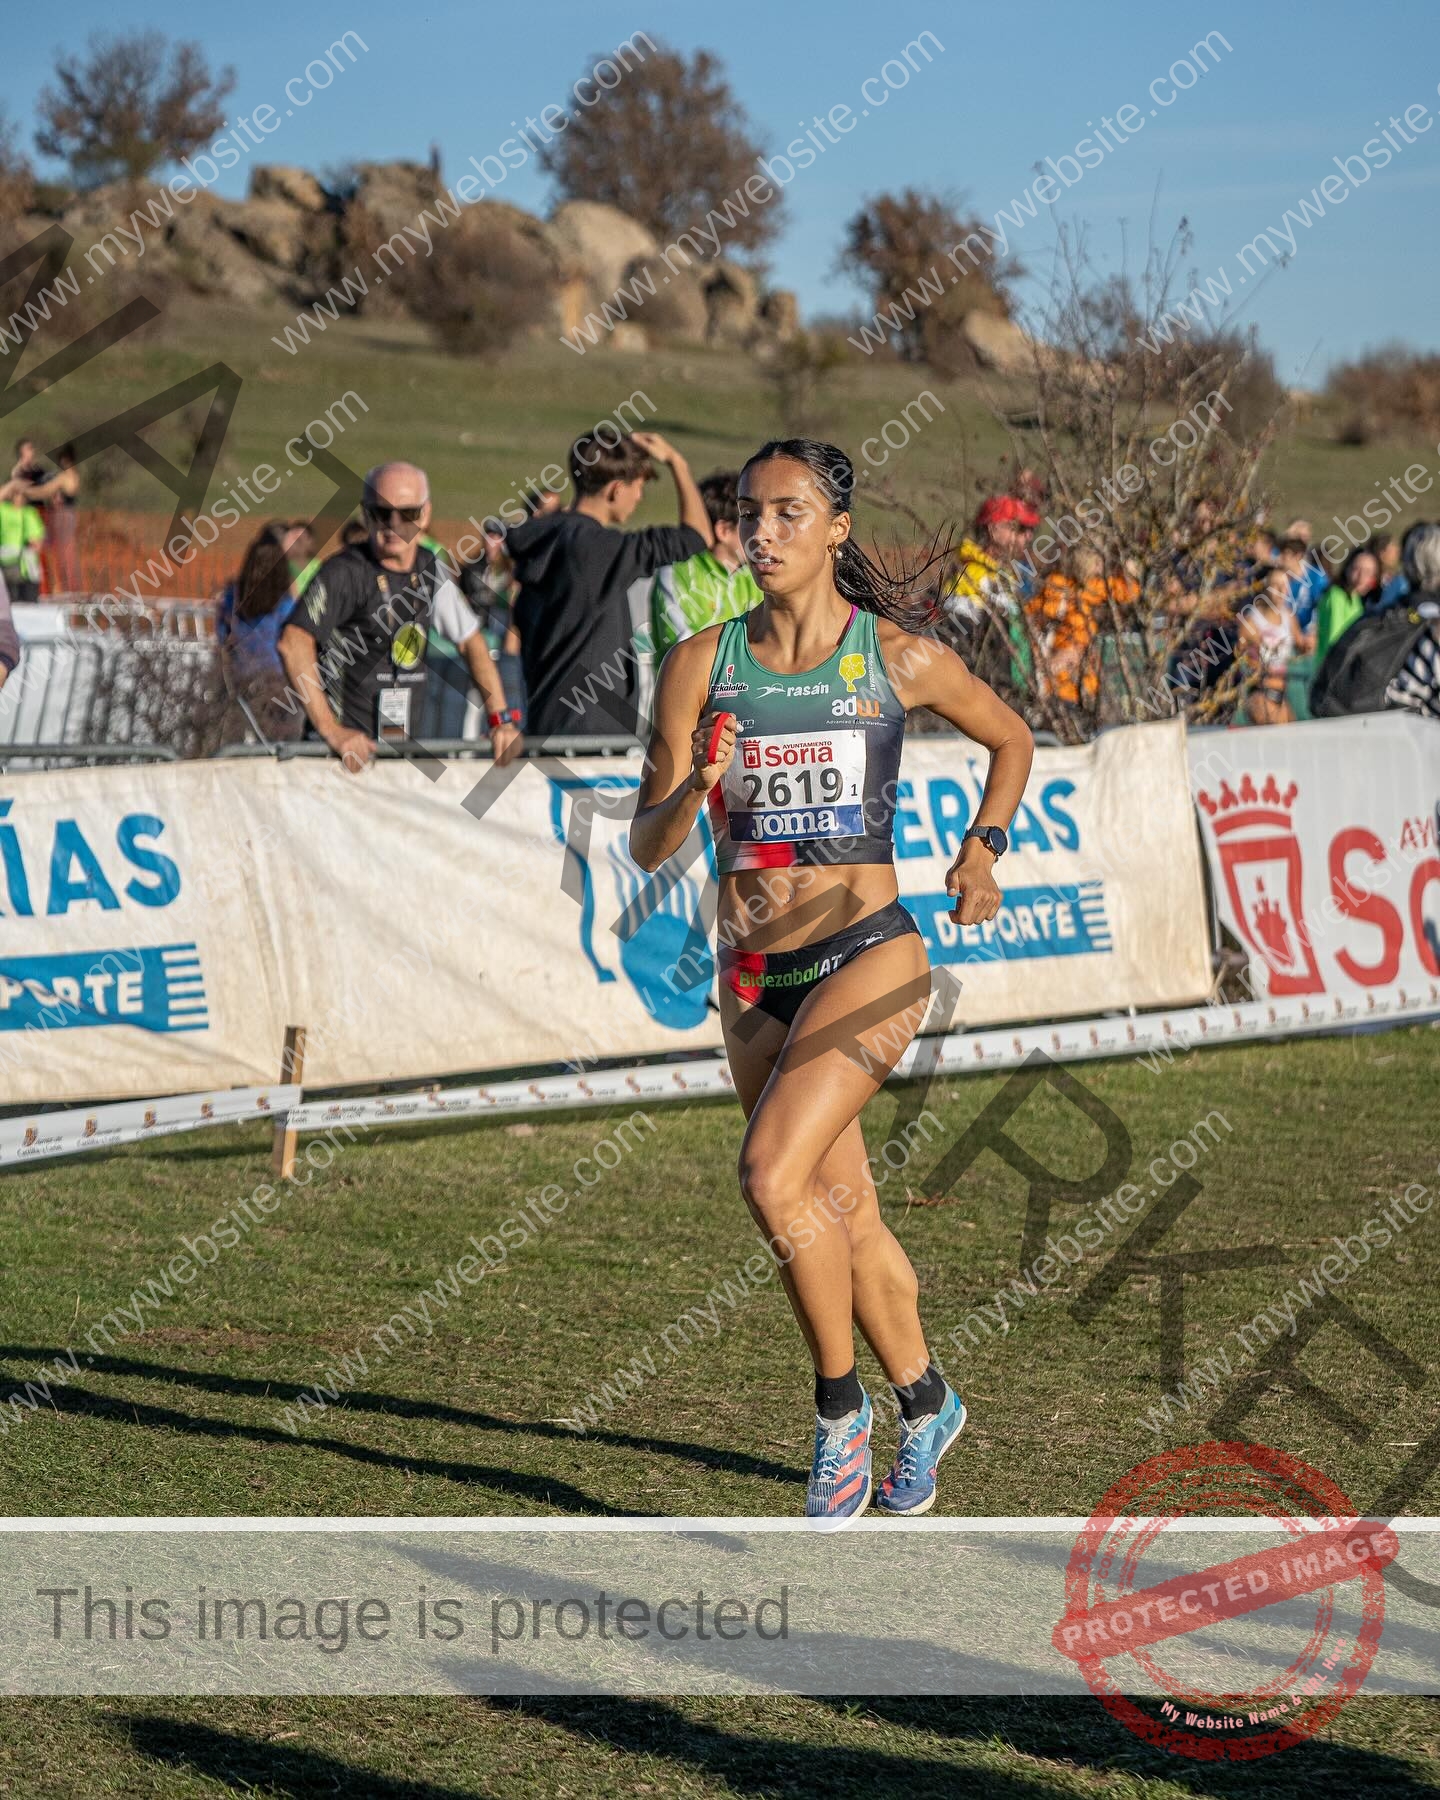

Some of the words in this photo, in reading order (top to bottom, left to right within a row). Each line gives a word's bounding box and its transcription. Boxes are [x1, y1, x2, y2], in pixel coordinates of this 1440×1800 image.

[787, 682, 829, 697] rasán
[764, 745, 834, 768] Soria
[782, 741, 832, 749] AYUNTAMIENTO
[742, 767, 844, 808] 2619
[850, 783, 858, 797] 1
[893, 757, 1081, 860] ERAS
[0, 798, 181, 916] ÍAS
[739, 953, 843, 988] BidezabalAT
